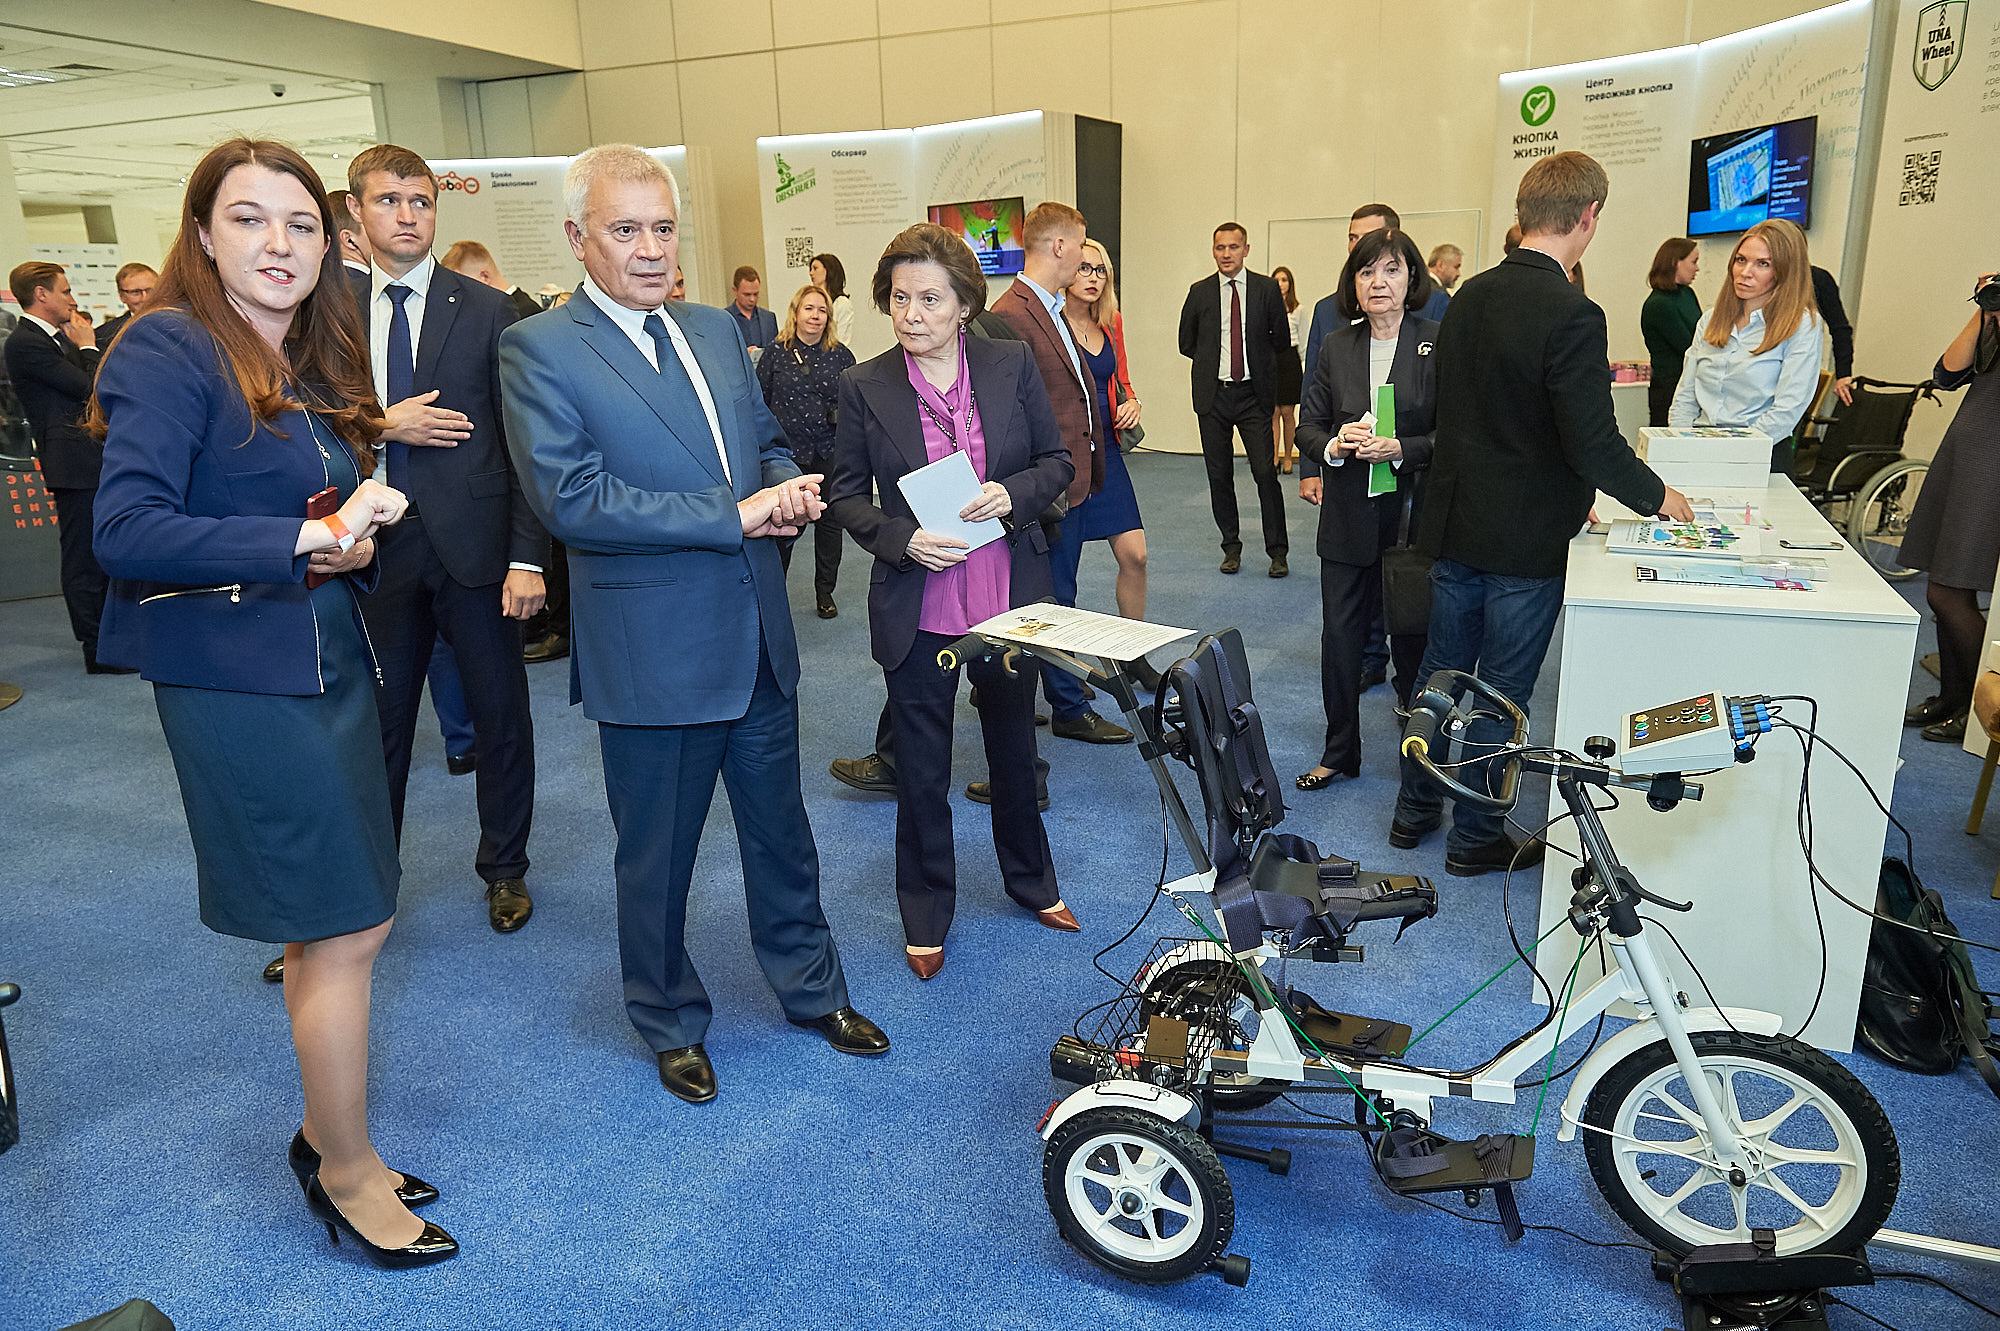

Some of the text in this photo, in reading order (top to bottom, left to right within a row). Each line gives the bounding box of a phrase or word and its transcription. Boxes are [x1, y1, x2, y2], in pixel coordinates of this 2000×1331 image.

[1928, 26, 1952, 44] UNA
[1922, 40, 1955, 61] Wheel
[1585, 77, 1614, 89] Центр
[1584, 82, 1673, 102] тревожная кнопка
[1512, 130, 1559, 145] КНОПКА
[831, 149, 868, 158] Обсервер
[1513, 145, 1556, 159] ЖИЗНИ
